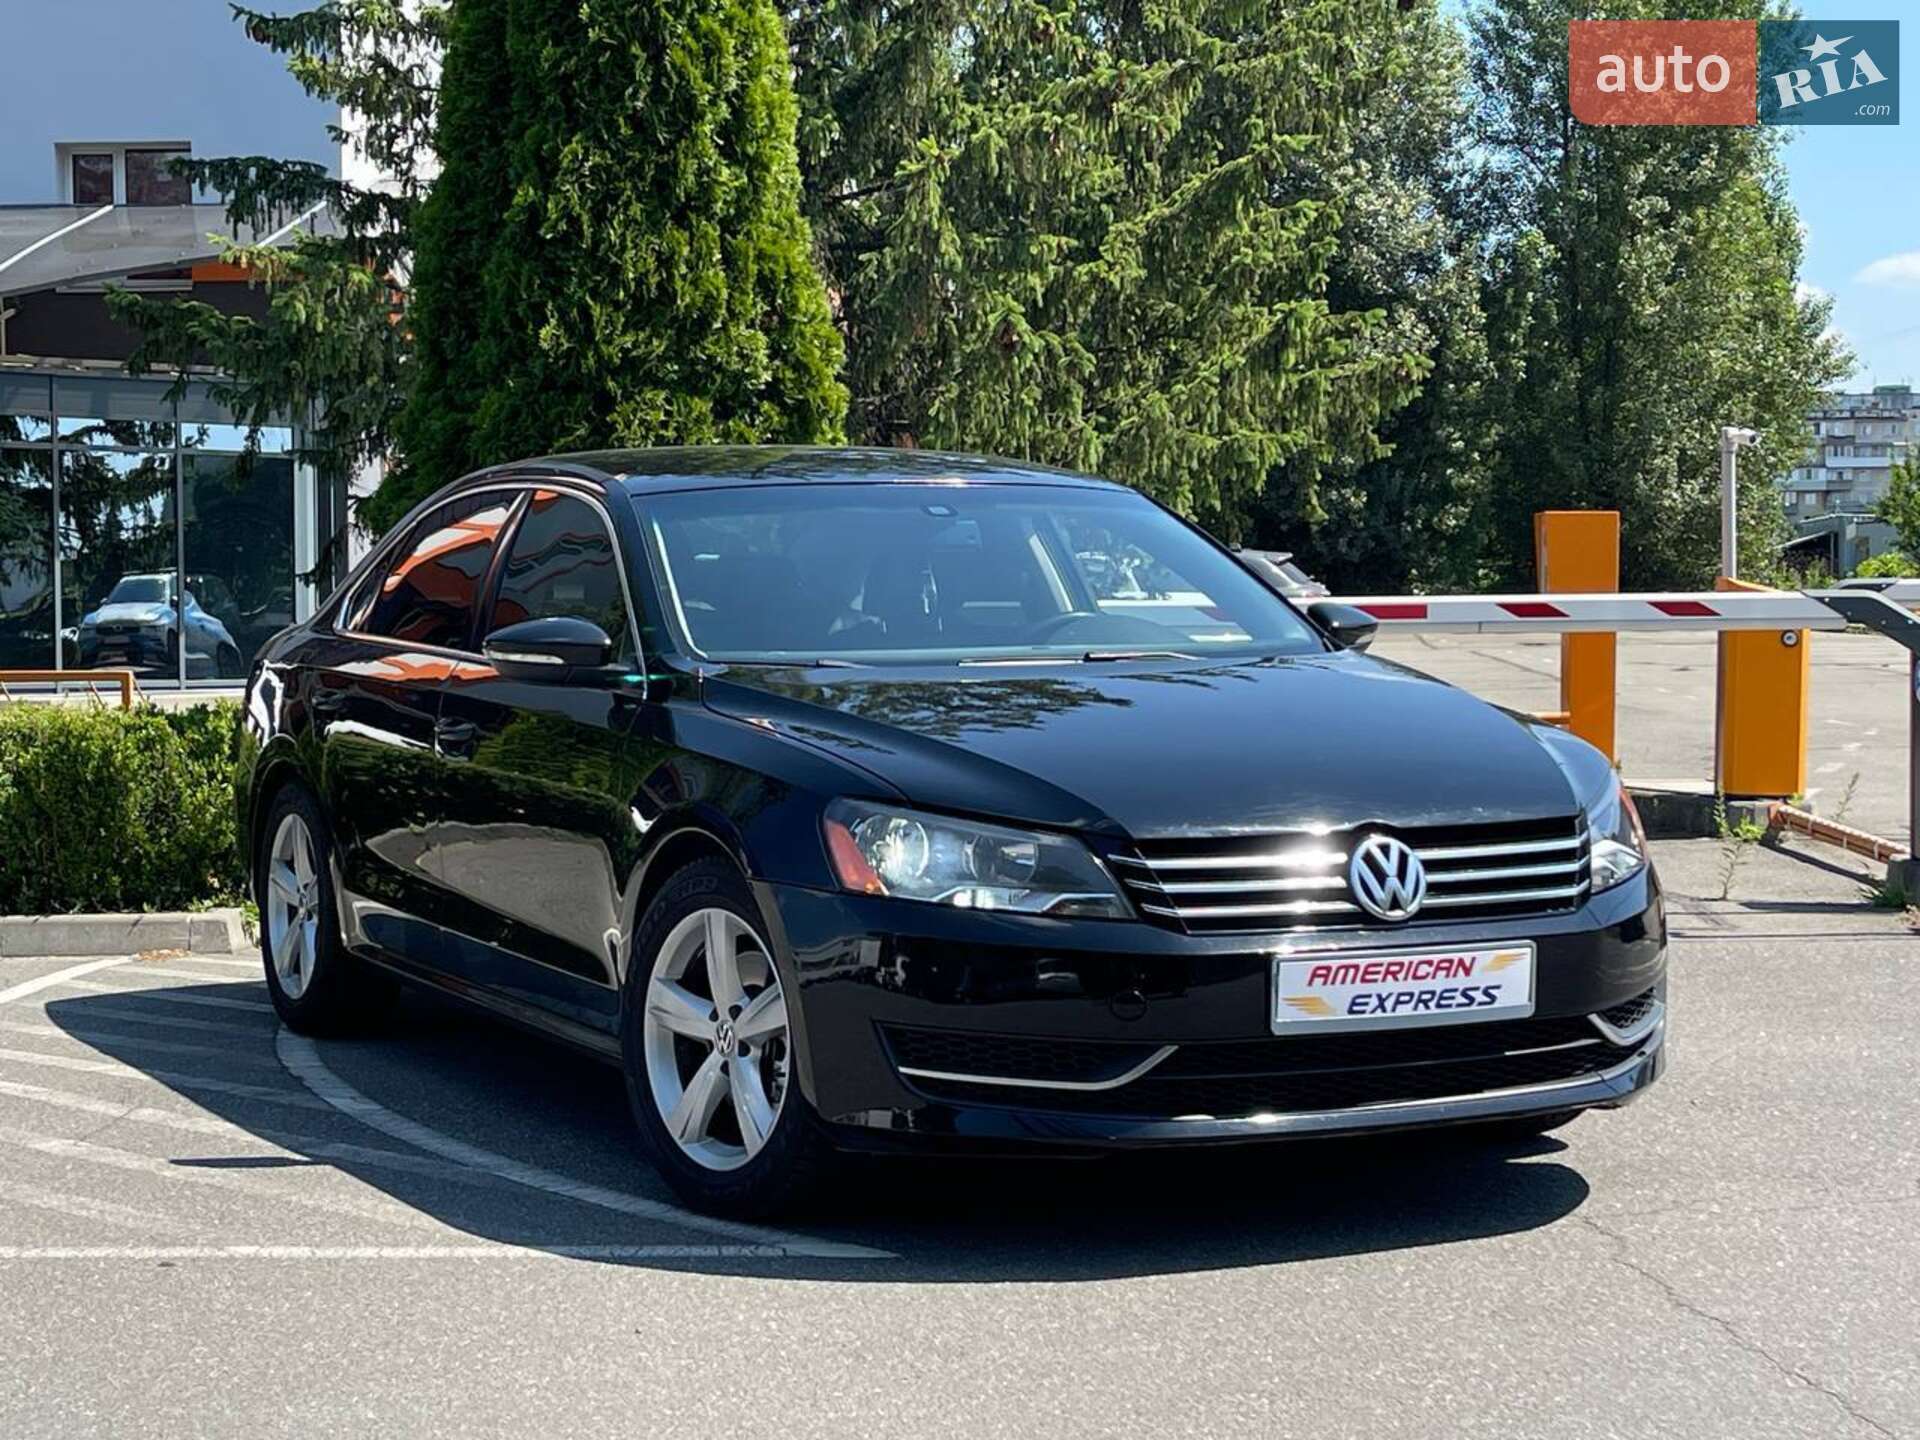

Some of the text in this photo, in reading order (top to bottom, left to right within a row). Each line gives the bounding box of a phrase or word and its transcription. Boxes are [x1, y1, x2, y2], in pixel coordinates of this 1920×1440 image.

[1351, 836, 1425, 918] VW
[1307, 957, 1476, 986] AMERICAN
[1347, 985, 1502, 1015] EXPRESS
